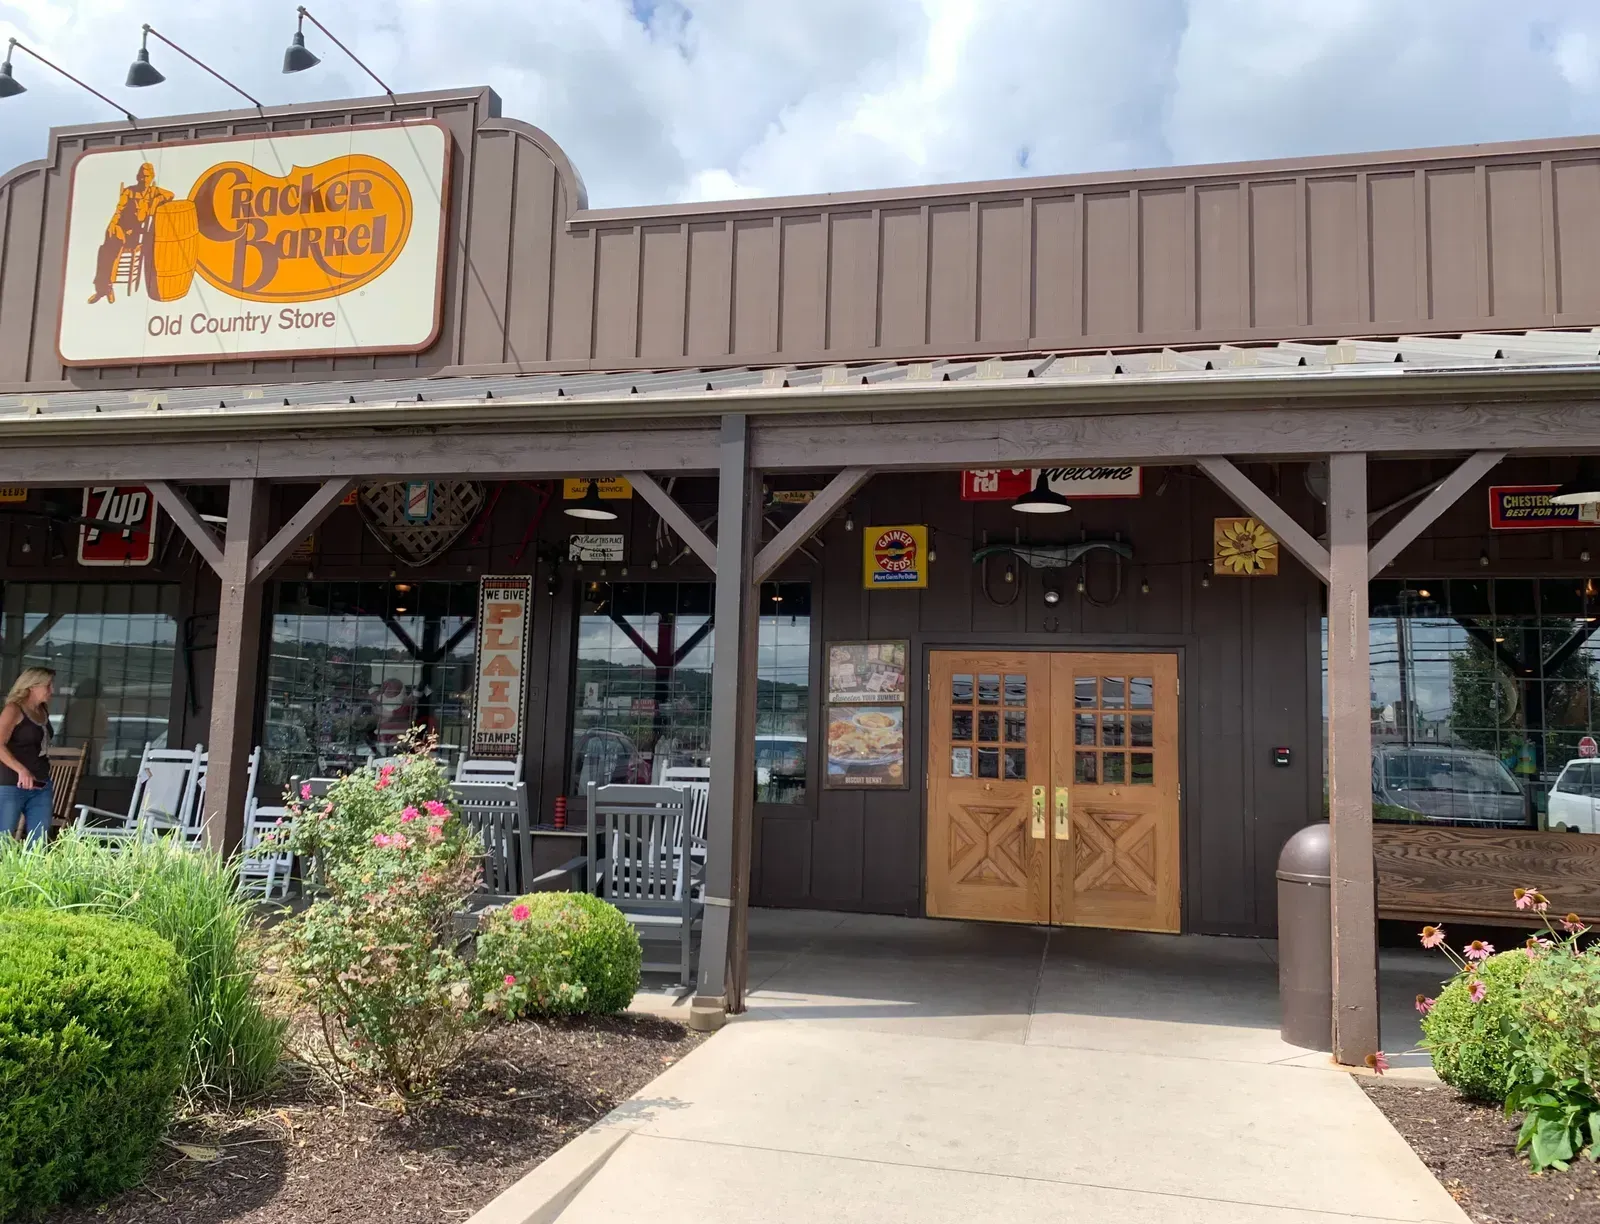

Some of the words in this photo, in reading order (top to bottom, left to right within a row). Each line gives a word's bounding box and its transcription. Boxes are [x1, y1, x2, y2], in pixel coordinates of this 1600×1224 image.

[148, 315, 183, 336] Old
[190, 311, 272, 334] Country
[278, 308, 336, 330] Store
[973, 473, 999, 493] red
[1506, 508, 1530, 517] BEST
[1531, 508, 1552, 517] FOR
[1554, 507, 1575, 516] YOU
[878, 531, 913, 547] GAINER
[880, 556, 911, 571] FEEDS
[486, 590, 500, 600] WE
[503, 590, 524, 600] GIVE
[480, 603, 523, 729] PLAID
[477, 732, 517, 743] STAMPS
